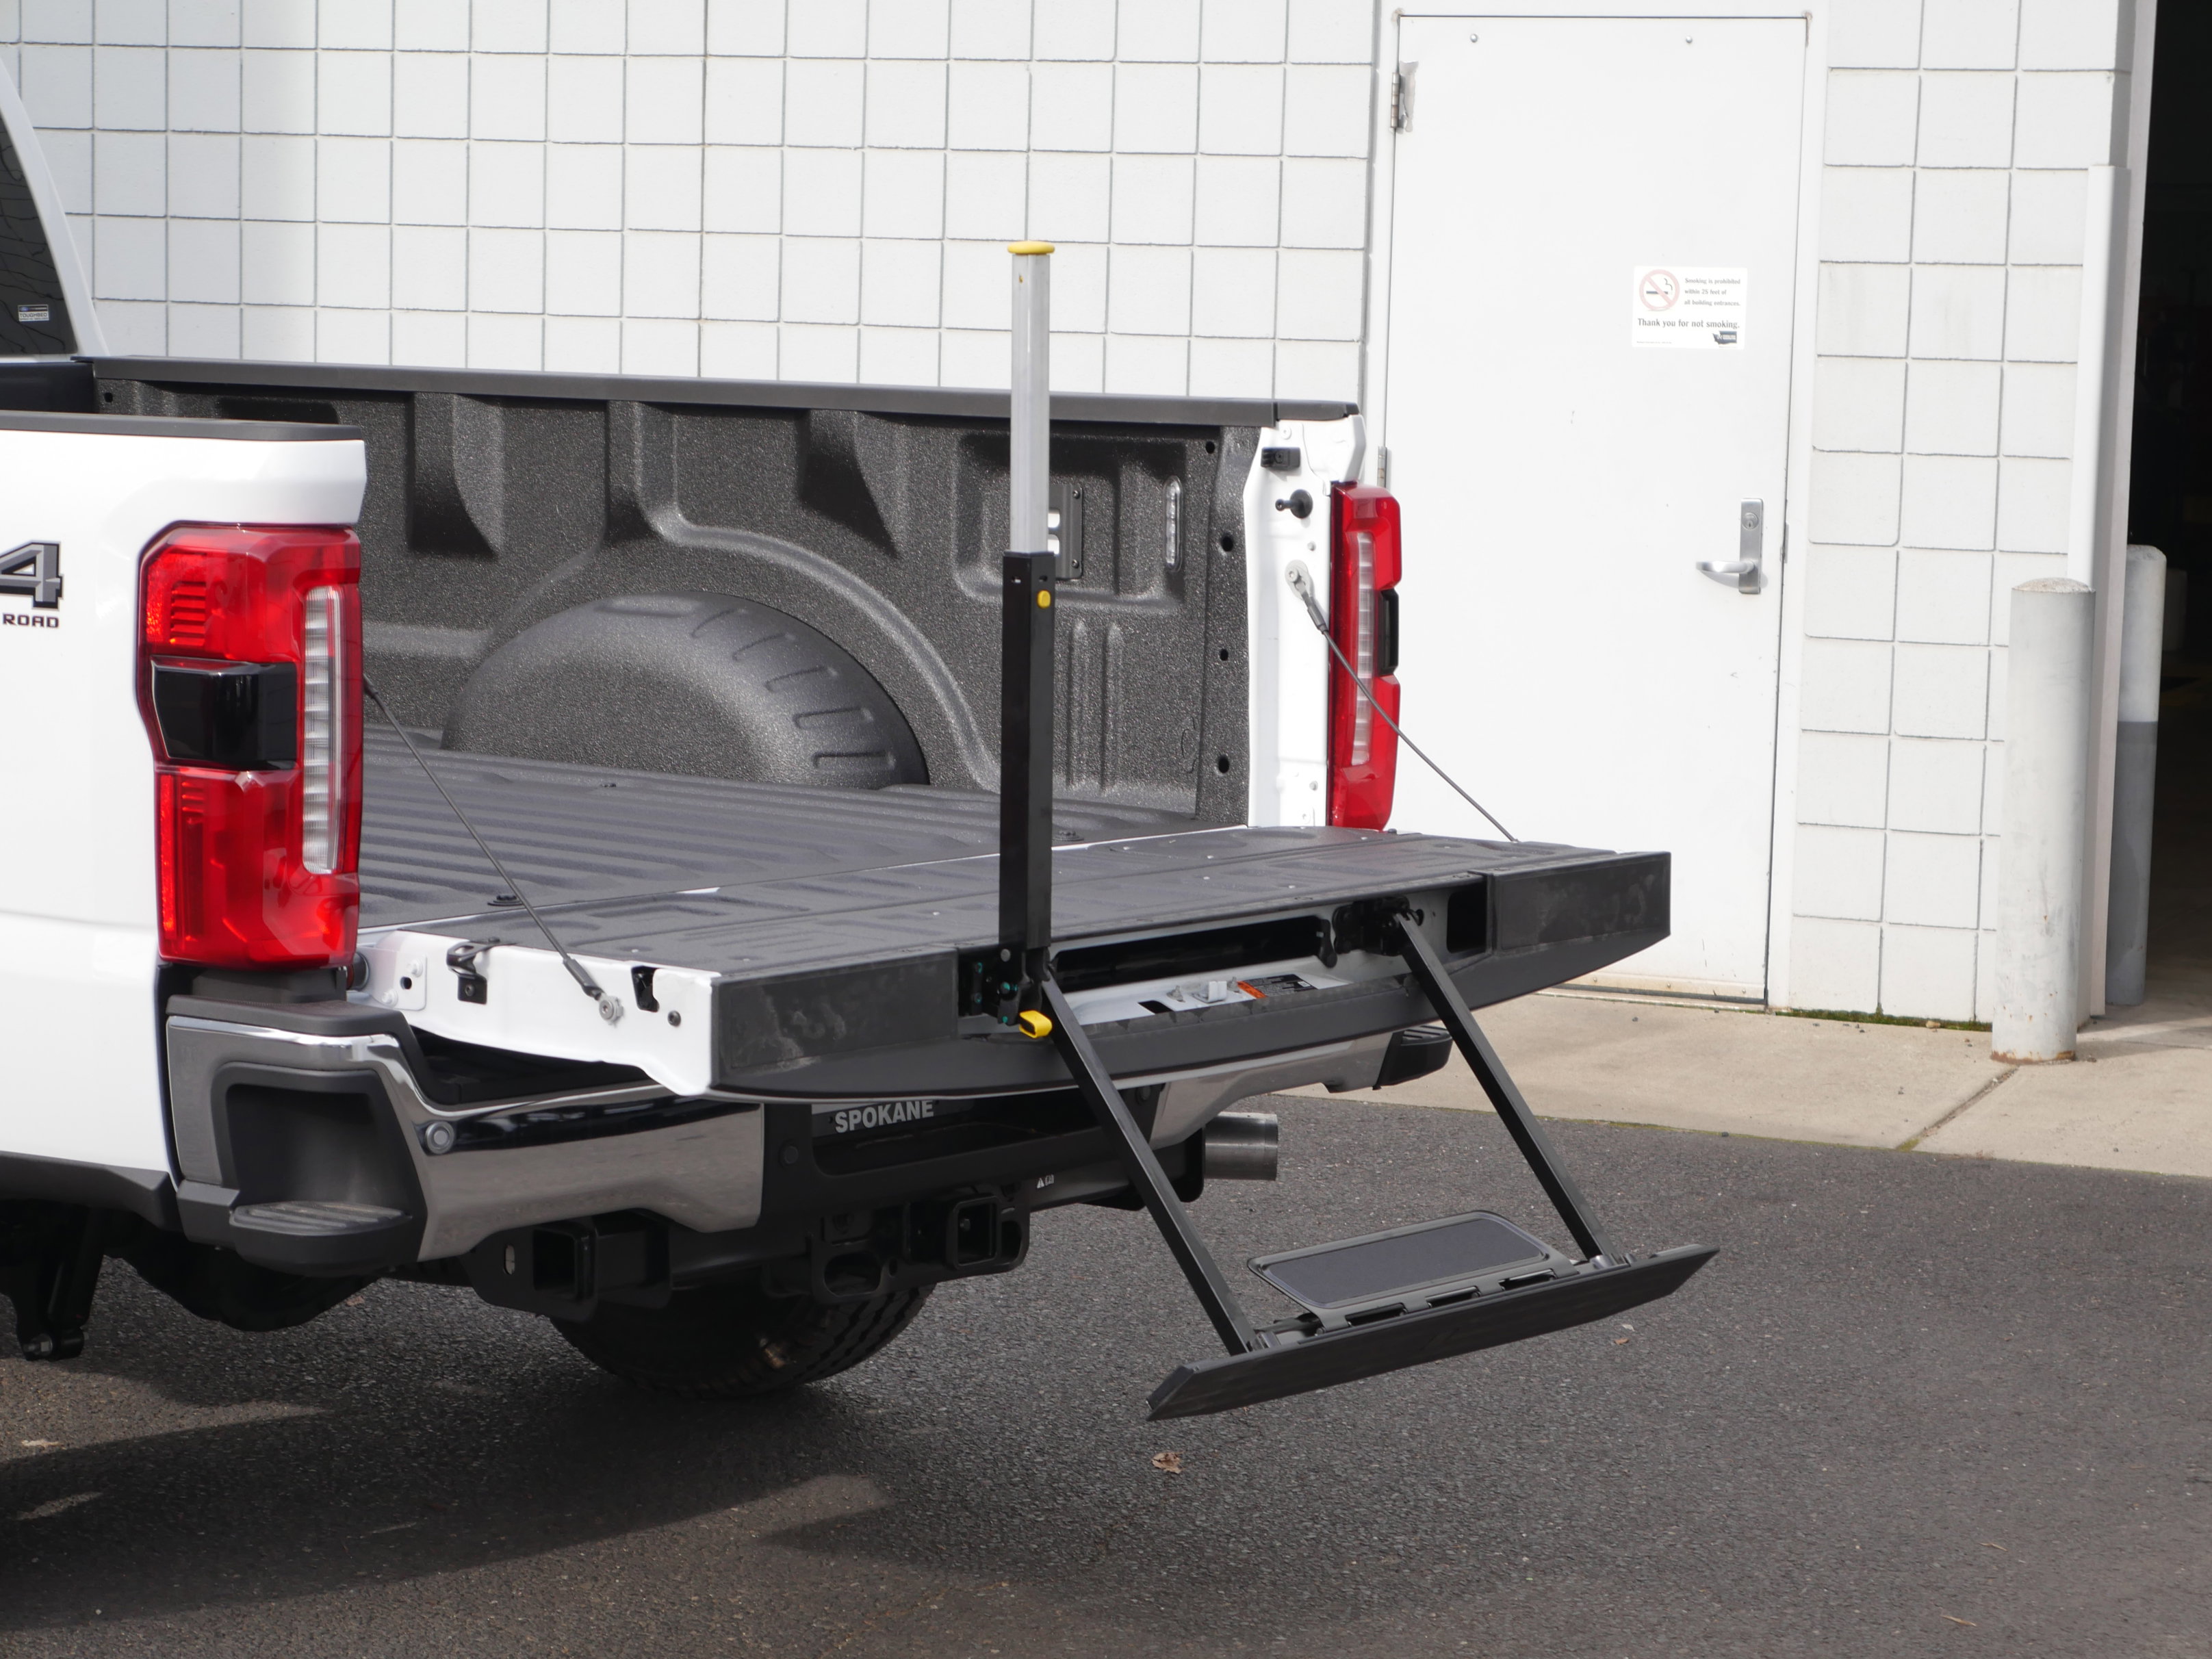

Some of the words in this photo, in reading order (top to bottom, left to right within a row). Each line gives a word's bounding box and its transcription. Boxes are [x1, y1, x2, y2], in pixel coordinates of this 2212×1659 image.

[1638, 318, 1660, 326] Thank
[1662, 320, 1676, 329] you
[1678, 318, 1689, 327] for
[1691, 320, 1704, 328] not
[1706, 320, 1740, 329] smoking.
[0, 541, 63, 610] 4
[3, 613, 60, 628] ROAD
[835, 1100, 934, 1133] SPOKANE
